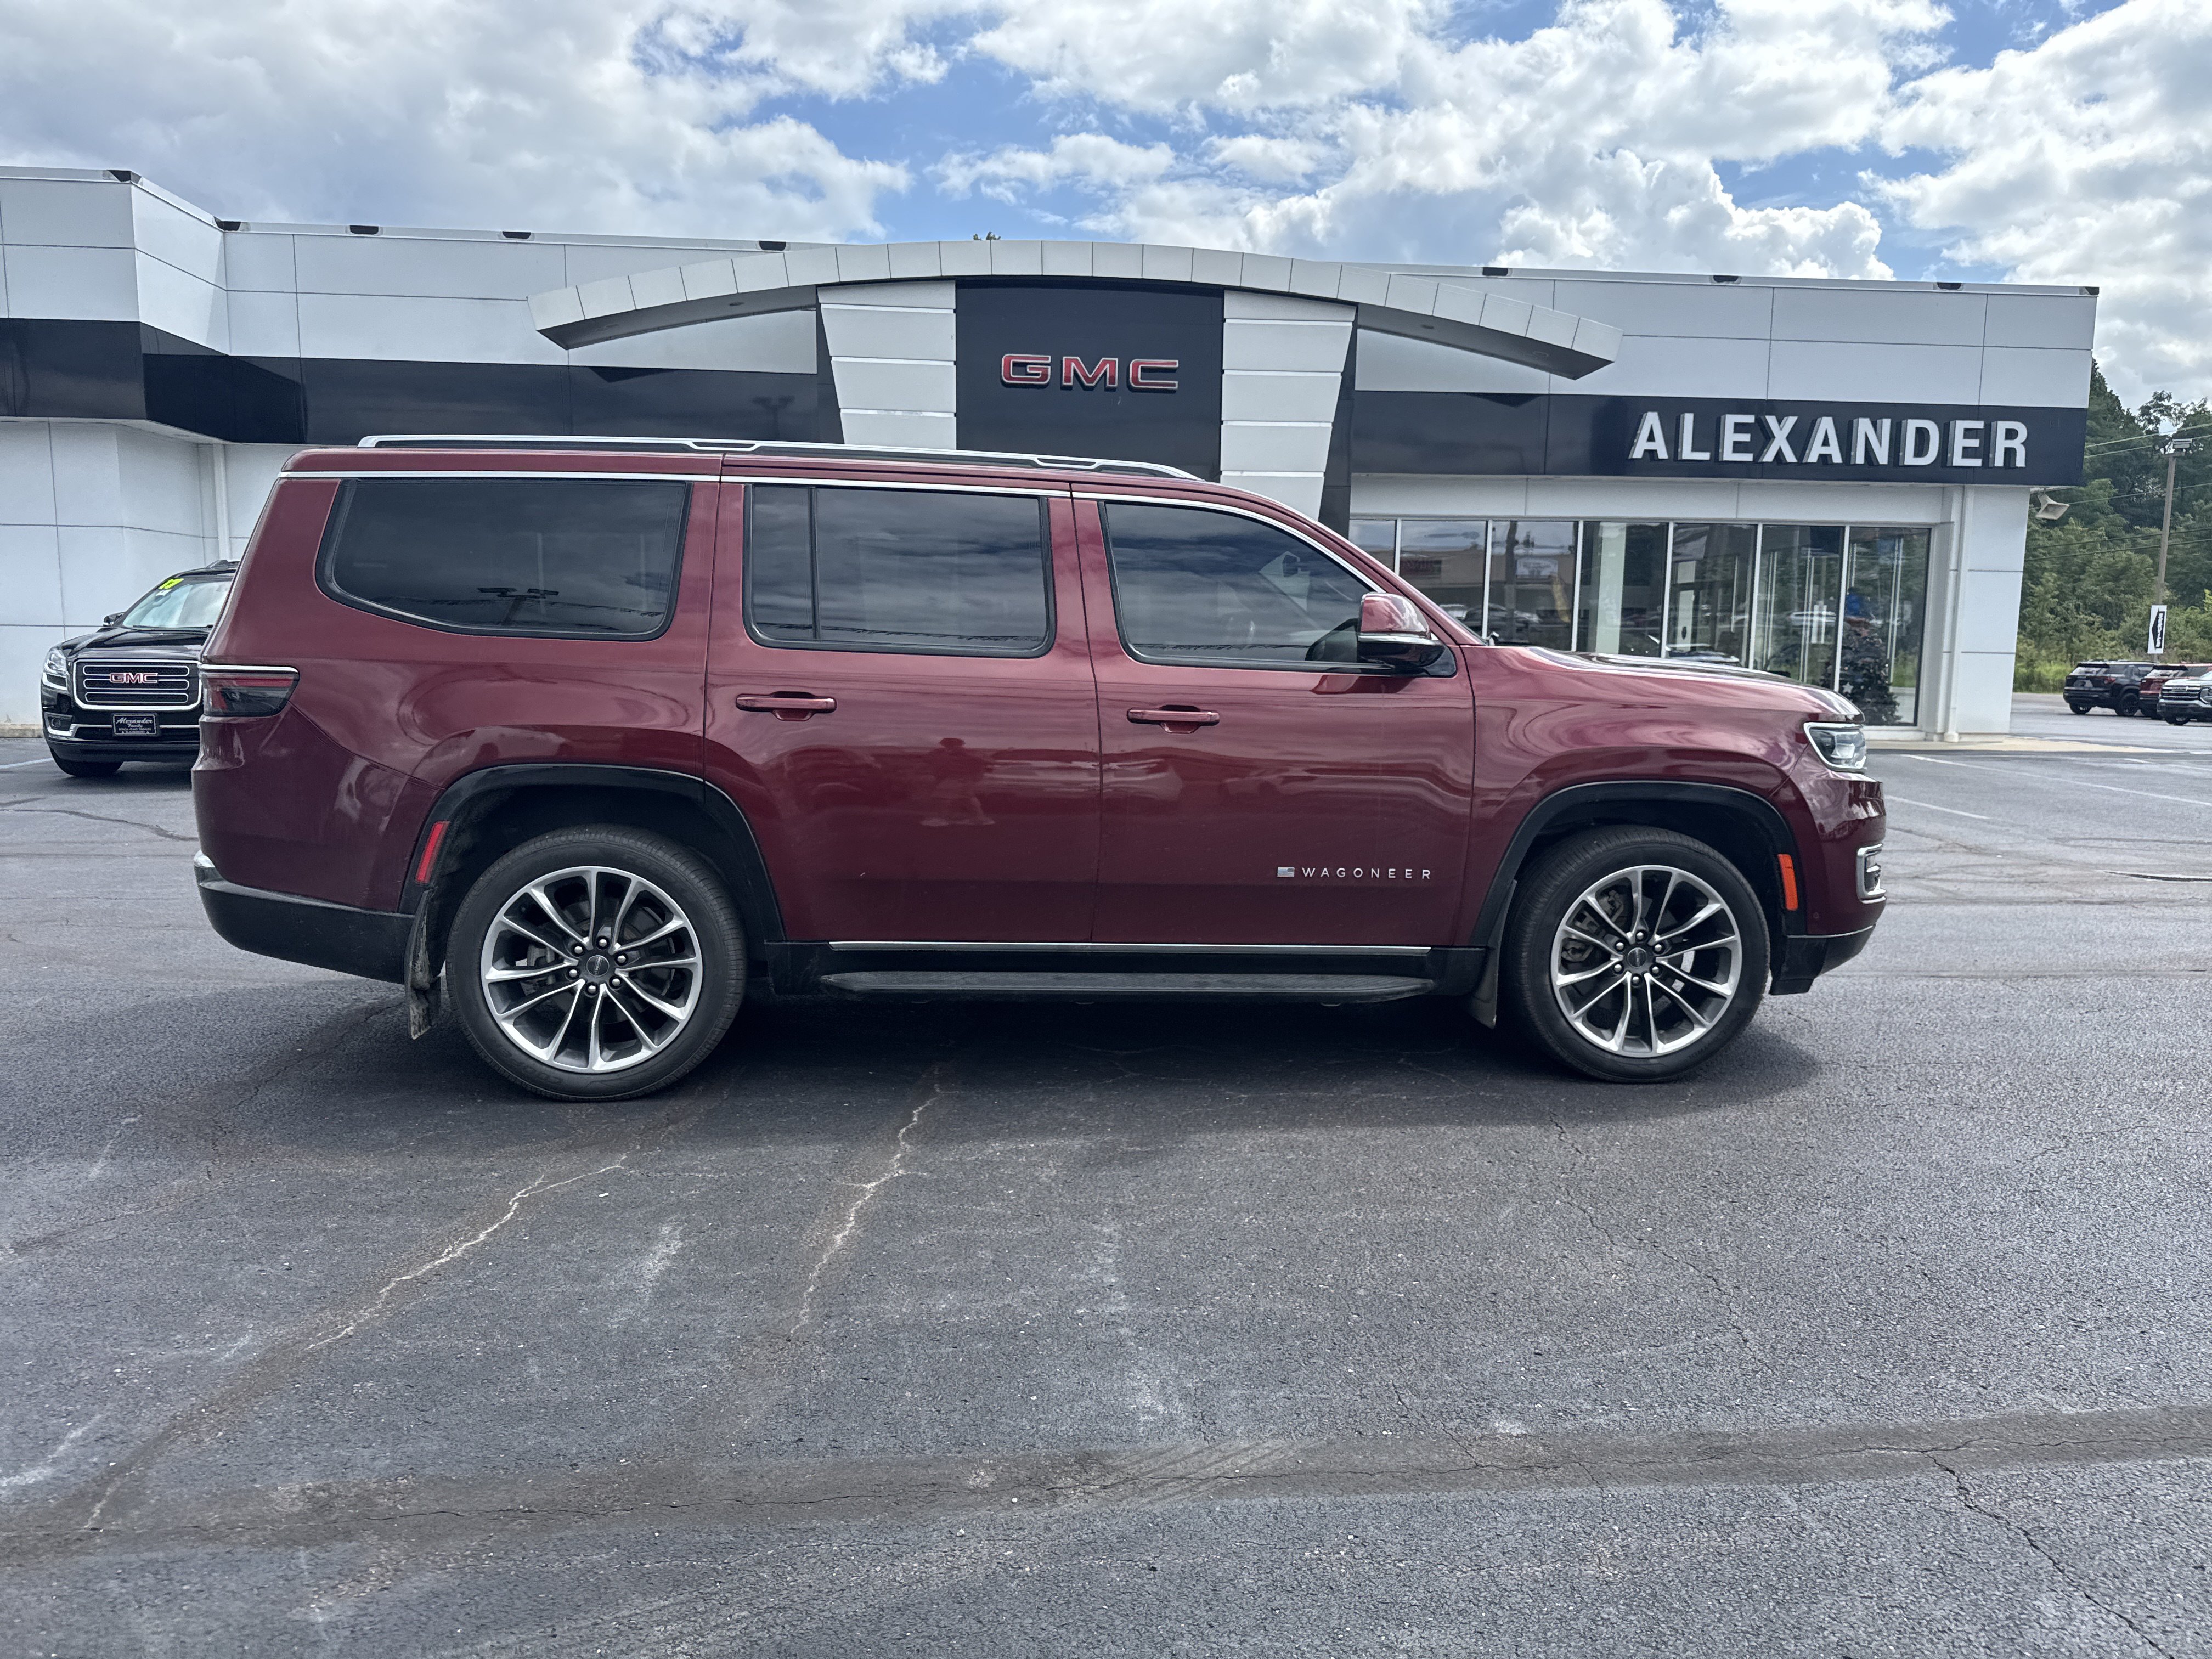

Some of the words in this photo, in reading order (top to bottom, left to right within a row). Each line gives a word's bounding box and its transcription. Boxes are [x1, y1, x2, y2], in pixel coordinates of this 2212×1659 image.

[1001, 354, 1178, 389] GMC
[1629, 411, 2029, 467] ALEXANDER
[158, 578, 184, 589] 17
[110, 673, 158, 683] GMC
[1302, 867, 1431, 879] WAGONEER
